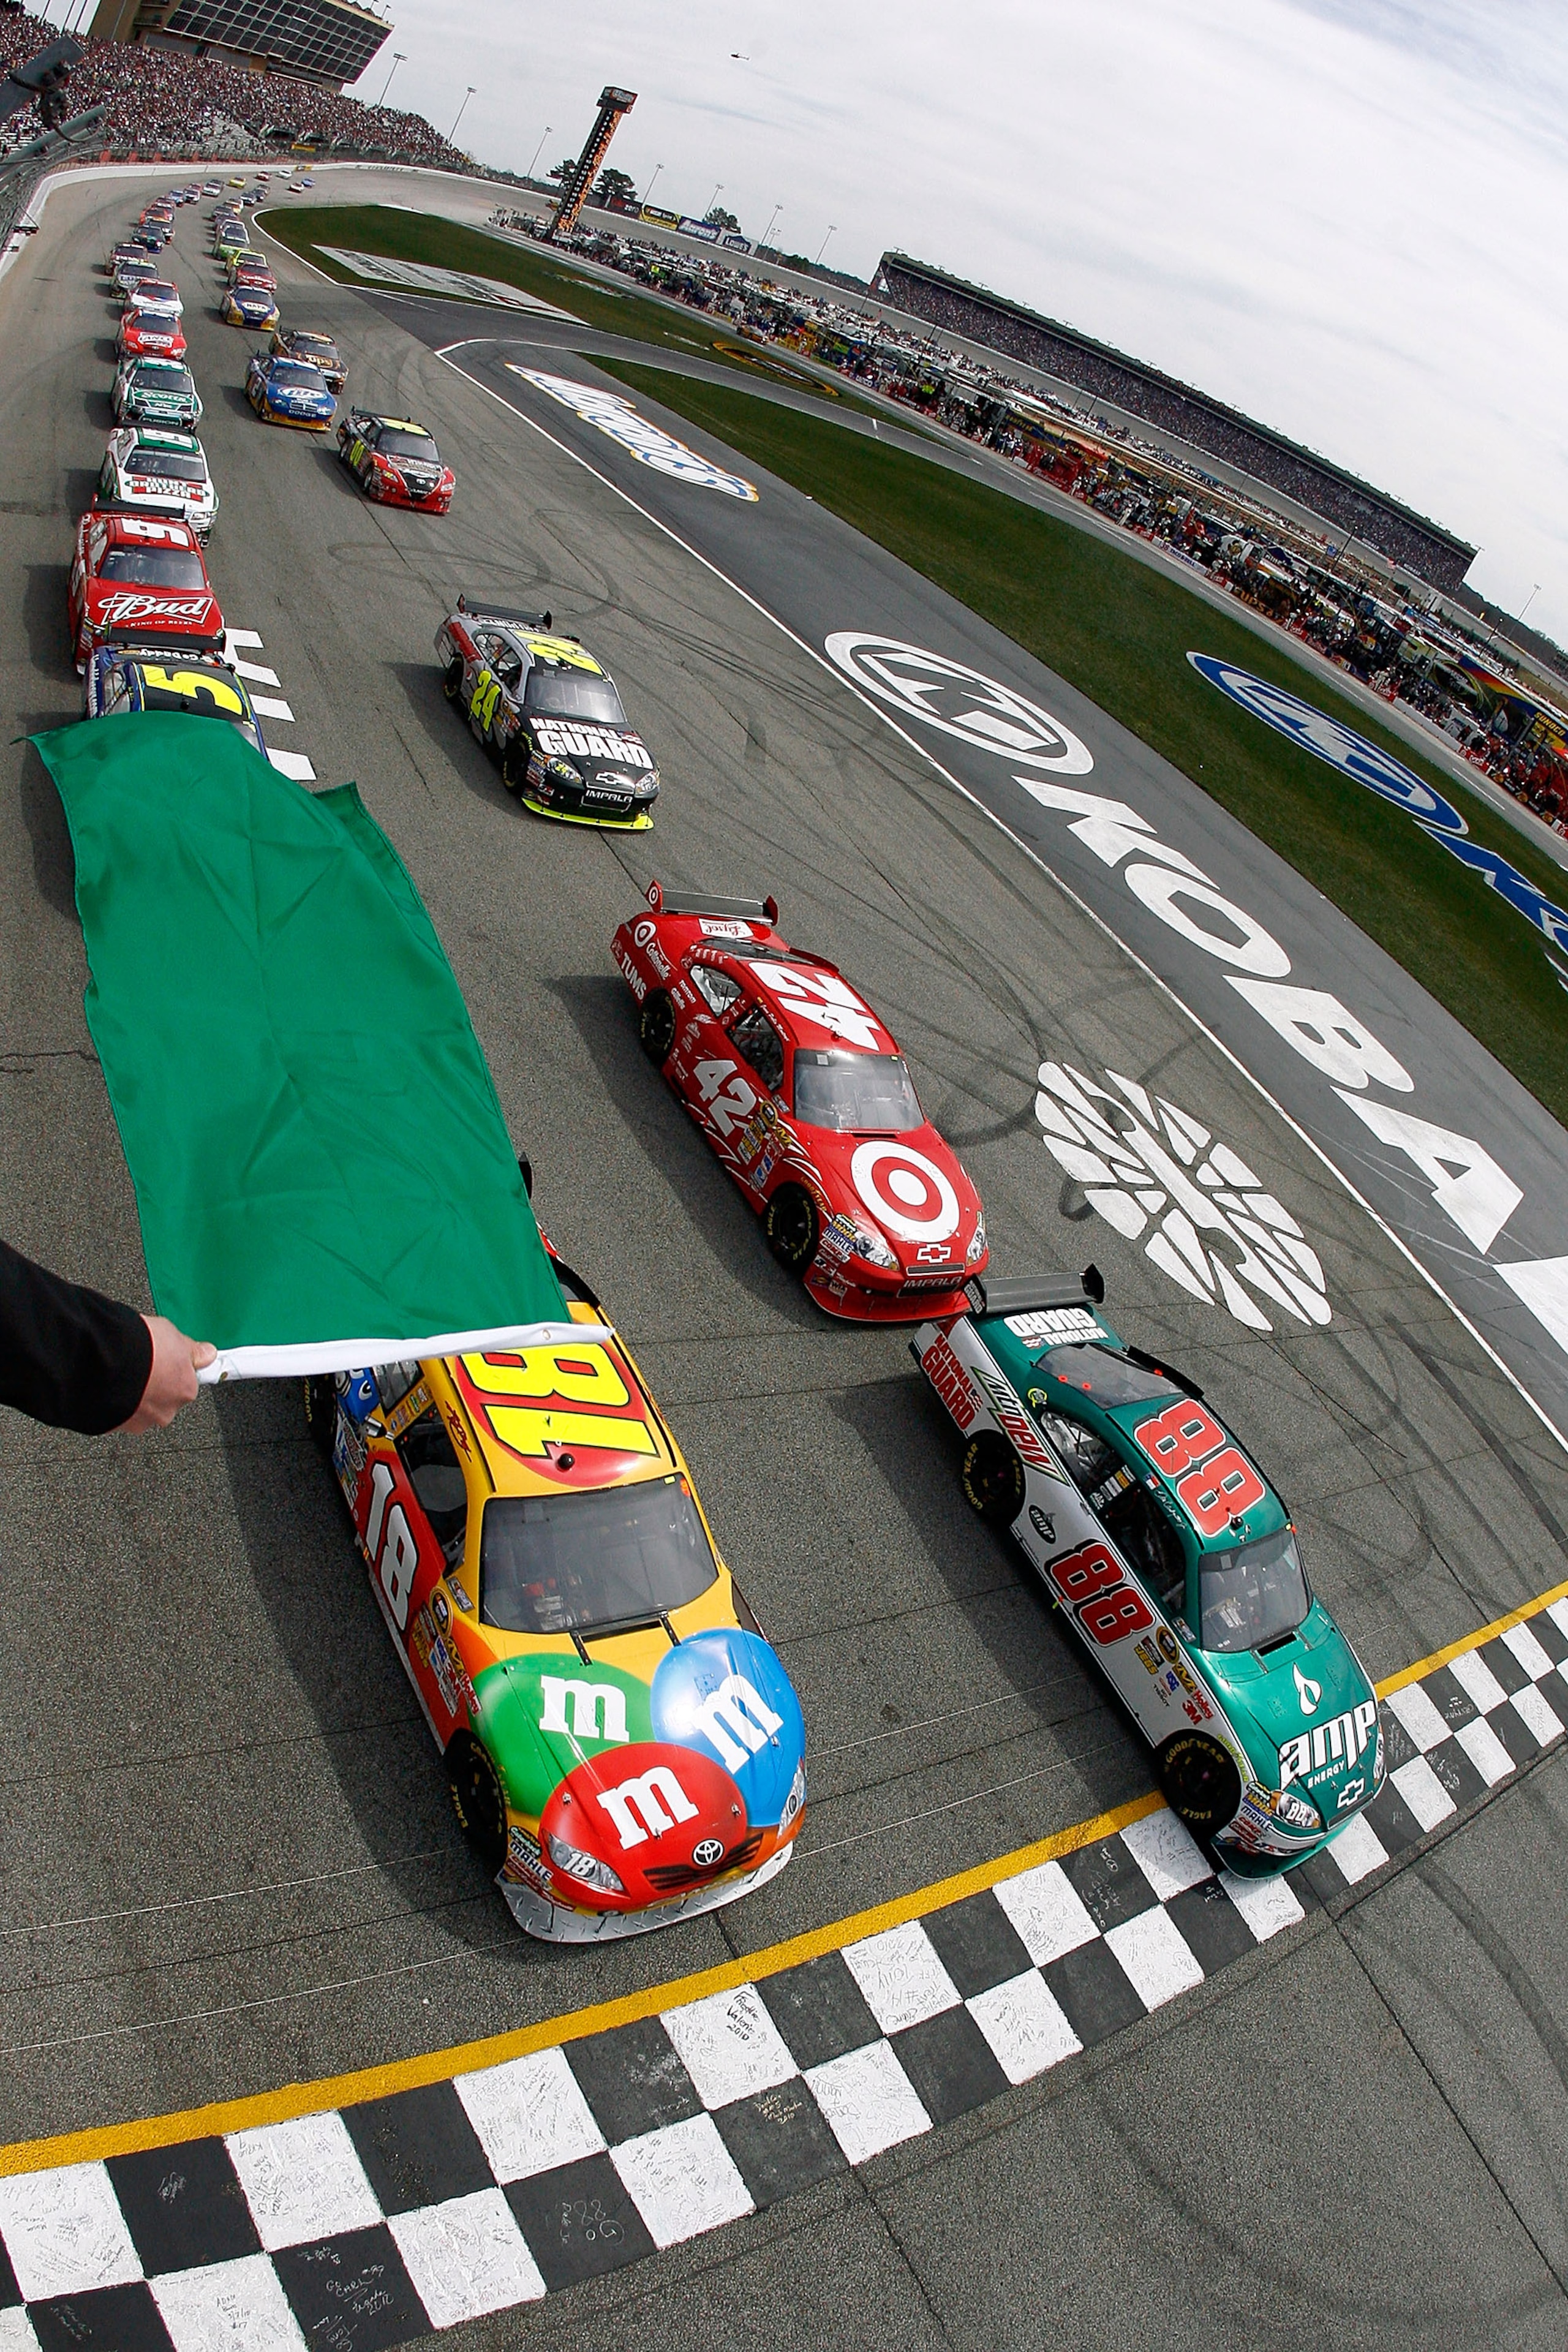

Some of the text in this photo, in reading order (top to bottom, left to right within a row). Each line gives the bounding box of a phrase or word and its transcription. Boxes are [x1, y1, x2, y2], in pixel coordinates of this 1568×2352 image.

[624, 204, 640, 214] zero
[678, 219, 718, 239] Aaron's
[725, 236, 749, 252] LOWE'S
[288, 409, 317, 418] DODGE
[146, 485, 192, 499] PIZZA
[98, 595, 203, 620] Bud
[141, 664, 243, 716] 5
[469, 669, 502, 733] 24
[529, 717, 624, 742] NATIONAL
[1533, 711, 1567, 737] SUNOCO
[537, 729, 654, 769] GUARD
[586, 790, 633, 803] IMPALA
[706, 921, 745, 936] Lysol
[646, 943, 672, 980] Cottonelle
[620, 952, 647, 1002] TUMS
[671, 987, 686, 1011] Gillette
[748, 961, 881, 1053] 42
[693, 1060, 757, 1137] 42
[824, 1229, 853, 1254] MAHLE
[832, 1220, 858, 1243] MOOG
[903, 1276, 962, 1288] IMPALA
[963, 1284, 982, 1314] GUARD
[1003, 1308, 1098, 1337] GUARD
[1042, 1327, 1109, 1346] NATIONAL
[933, 1333, 974, 1393] NATIONAL
[459, 1342, 661, 1459] 18
[921, 1345, 976, 1430] GUARD
[962, 1442, 983, 1510] GOODYEAR
[1134, 1398, 1267, 1537] 88
[1031, 1509, 1055, 1540] amp
[366, 1463, 417, 1630] 18
[1050, 1540, 1156, 1648] 88
[1134, 1645, 1159, 1675] JEGS
[461, 1673, 483, 1716] Holley
[539, 1675, 630, 1743] m
[1194, 1689, 1215, 1720] Holley
[692, 1674, 785, 1775] m
[1182, 1700, 1204, 1725] 3M
[1166, 1738, 1224, 1764] GOODYEAR
[1216, 1734, 1249, 1782] GOODYEAR
[1279, 1699, 1377, 1791] amp
[1306, 1760, 1345, 1789] ENERGY
[596, 1766, 699, 1850] m
[1182, 1807, 1212, 1820] EAGLE
[1240, 1806, 1273, 1832] MAHLE
[1246, 1793, 1273, 1817] MOOG
[1286, 1802, 1306, 1822] 88
[510, 1841, 552, 1882] MAHLE
[563, 1852, 597, 1877] 18
[726, 2024, 750, 2041] 2010
[573, 2199, 607, 2226] 88
